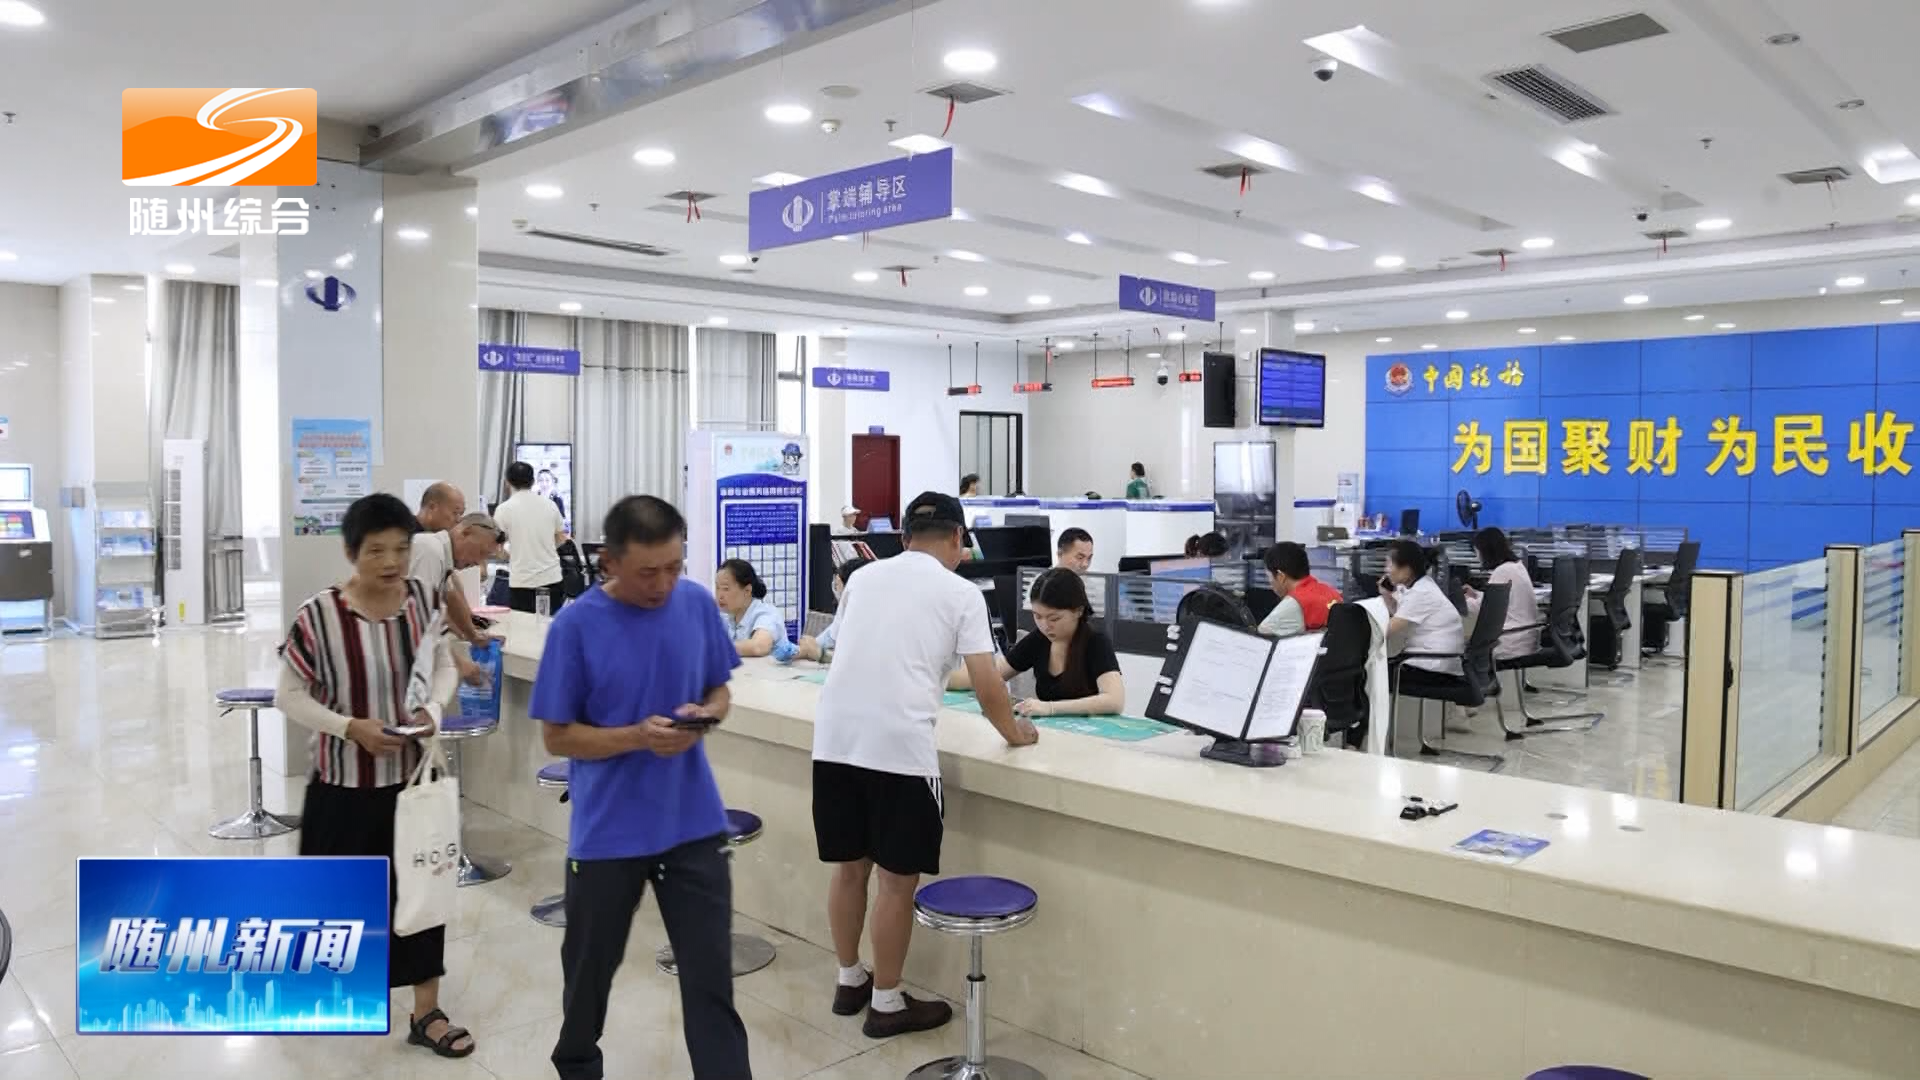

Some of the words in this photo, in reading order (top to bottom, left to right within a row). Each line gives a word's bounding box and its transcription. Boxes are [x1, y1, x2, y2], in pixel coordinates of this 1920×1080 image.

[827, 174, 907, 212] 掌端辅导区
[883, 203, 902, 214] area
[1423, 360, 1525, 393] 中国税务
